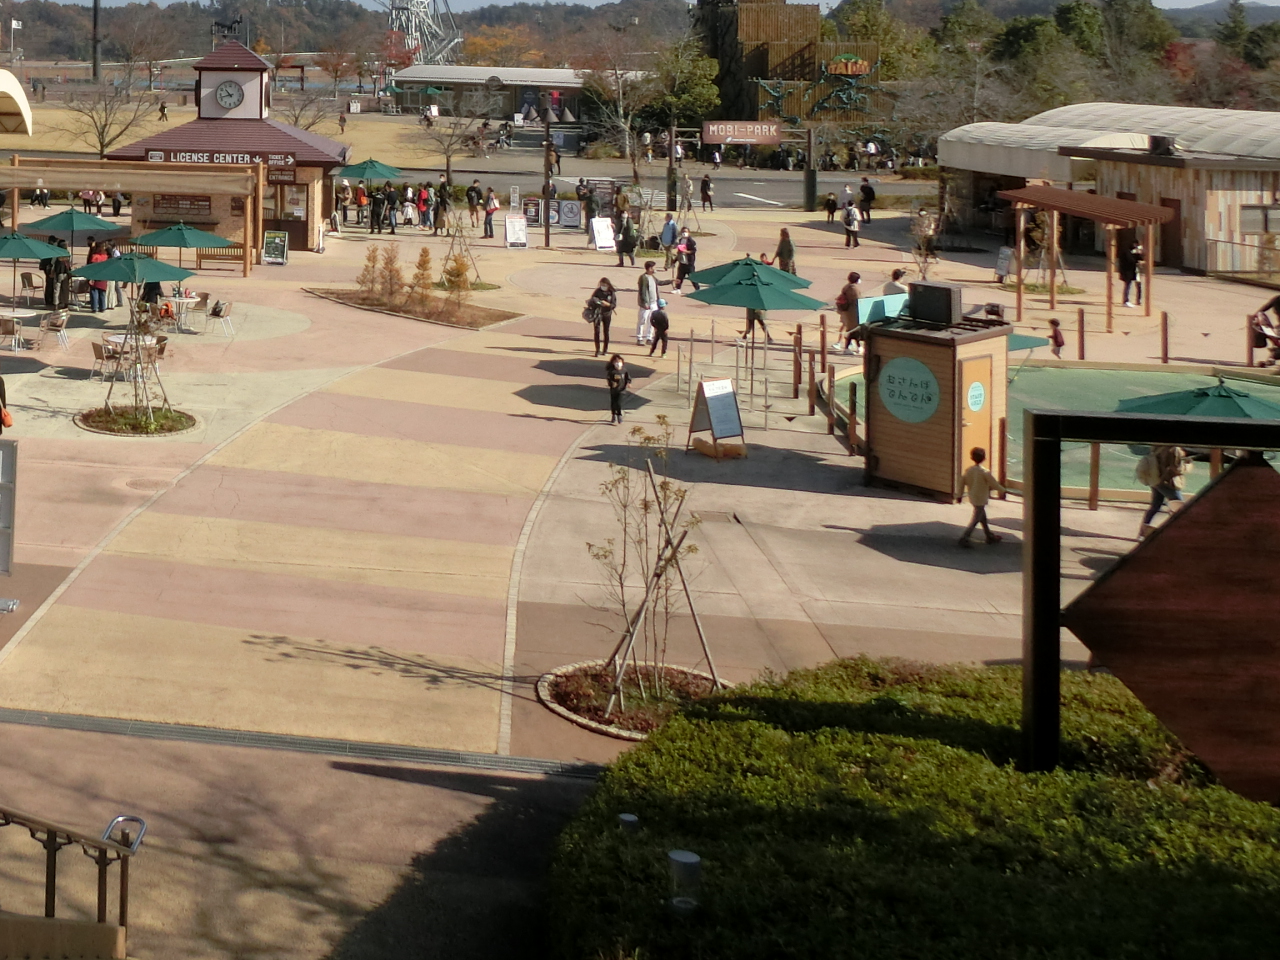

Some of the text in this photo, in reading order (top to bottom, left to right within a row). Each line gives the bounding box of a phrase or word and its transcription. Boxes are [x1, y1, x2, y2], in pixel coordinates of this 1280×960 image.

[708, 124, 778, 136] MOBI-PARK
[170, 152, 210, 163] LICENSE
[213, 153, 251, 164] CENTER
